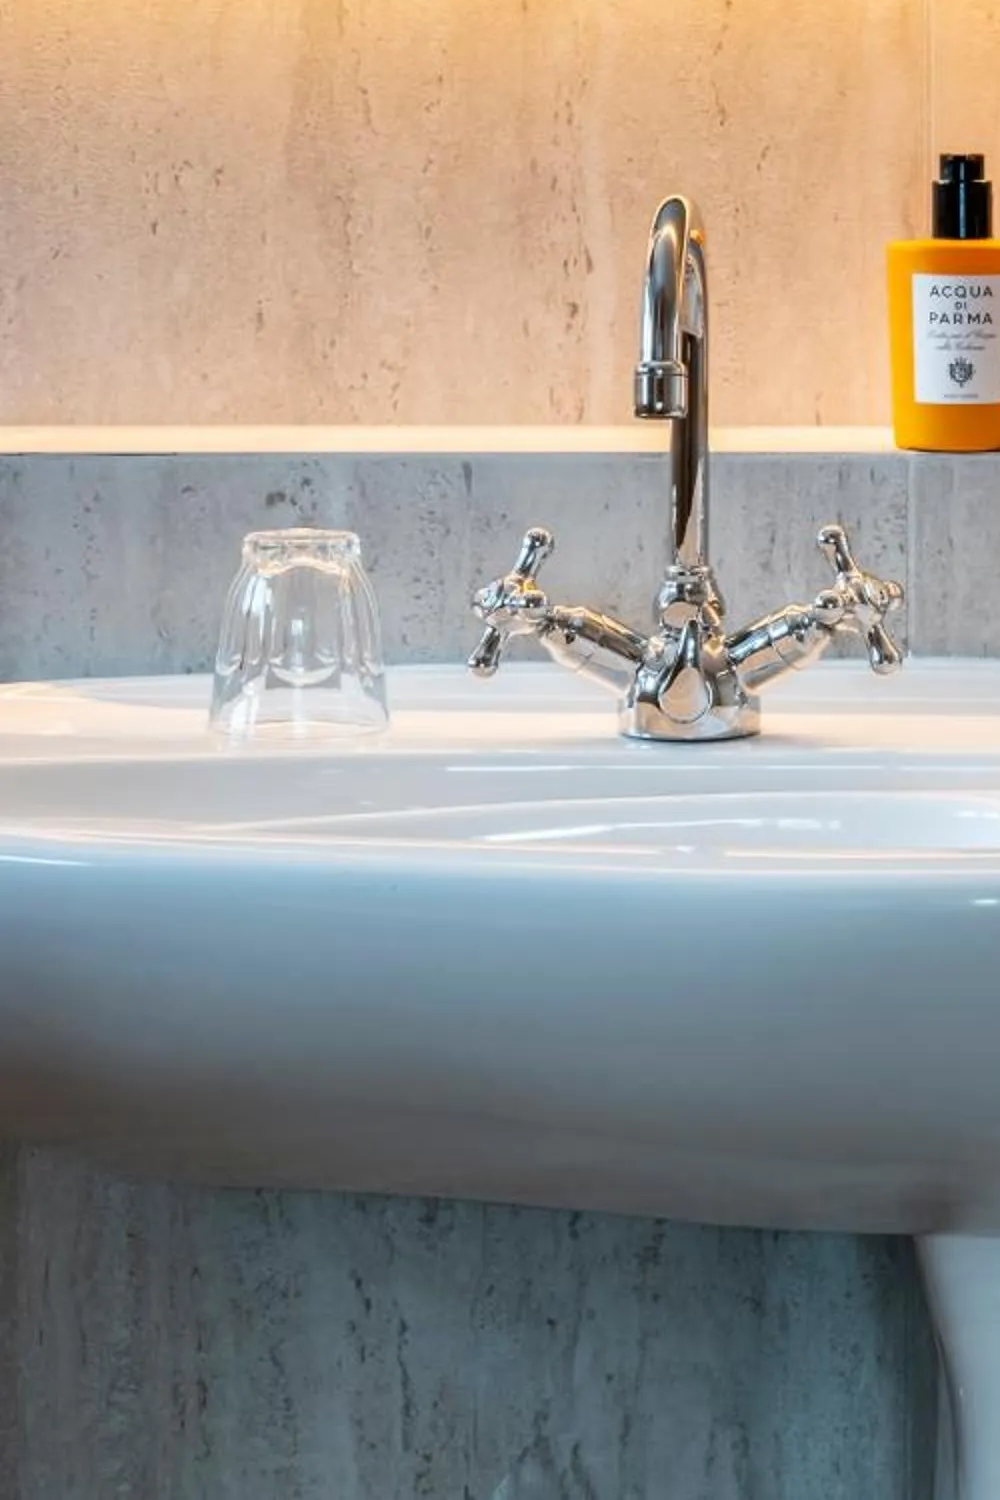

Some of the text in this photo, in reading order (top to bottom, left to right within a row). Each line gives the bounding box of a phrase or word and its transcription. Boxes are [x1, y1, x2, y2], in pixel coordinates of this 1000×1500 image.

[929, 284, 994, 299] ACQUA
[954, 301, 968, 311] DI
[929, 312, 994, 325] PARMA
